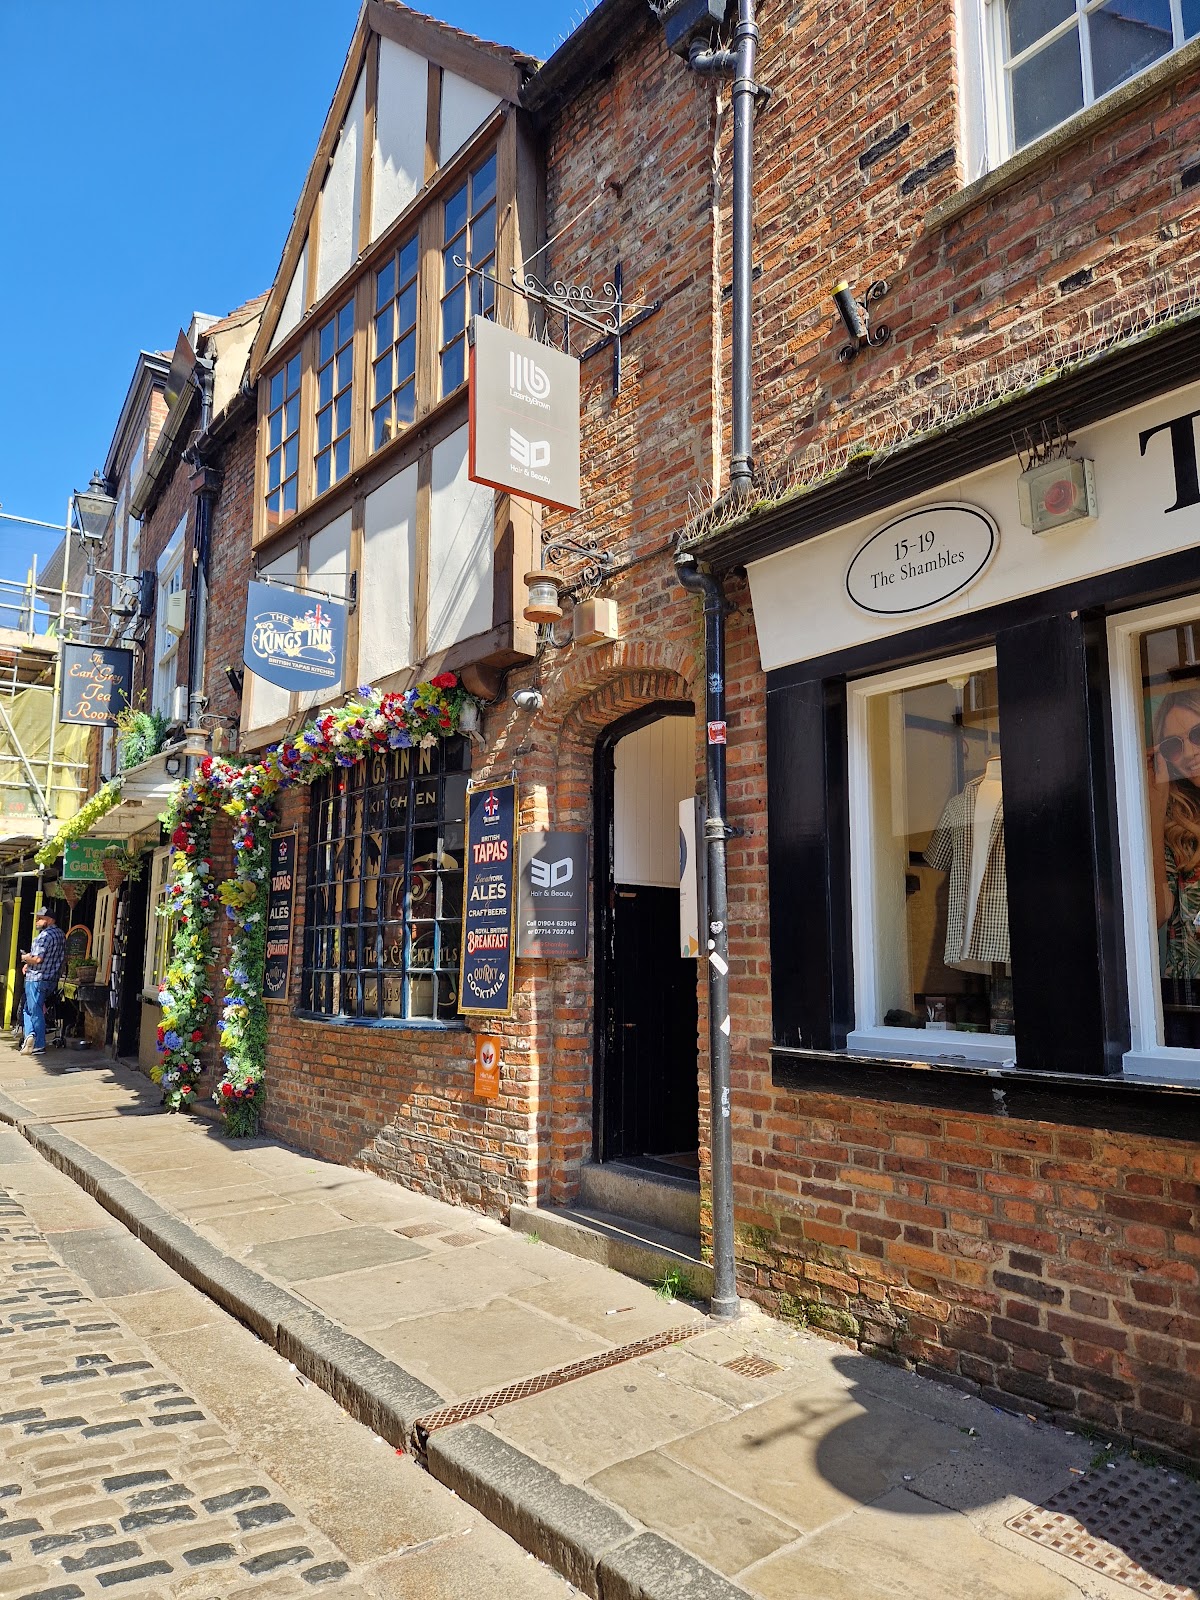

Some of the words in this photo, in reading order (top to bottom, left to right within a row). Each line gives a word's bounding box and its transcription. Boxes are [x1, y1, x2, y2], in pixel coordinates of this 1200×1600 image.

[509, 427, 551, 469] 3D
[510, 463, 523, 474] Hair
[523, 468, 530, 477] &
[530, 470, 551, 485] Beauty
[894, 530, 935, 561] 15-19
[870, 571, 895, 589] The
[900, 549, 965, 581] Shambles
[269, 613, 290, 623] THE
[259, 627, 302, 654] KINGS
[307, 628, 332, 651] INN
[89, 653, 104, 664] The
[268, 657, 292, 667] BRITISH
[291, 662, 311, 672] TAPAS
[311, 665, 336, 677] KITCHEN
[69, 663, 95, 679] Earl
[94, 665, 124, 685] Grey
[82, 683, 112, 701] Tea
[481, 833, 501, 843] BRITISH
[473, 840, 508, 863] TAPAS
[530, 857, 574, 888] 3D
[271, 874, 292, 892] TAPAS
[469, 882, 507, 901] ALES
[530, 890, 543, 898] Hair
[543, 889, 550, 898] &
[550, 889, 574, 899] Beauty
[269, 906, 290, 919] ALES
[468, 908, 488, 918] CRAFT
[488, 907, 507, 916] BEERS
[490, 926, 509, 934] BRITISH
[467, 930, 509, 954] BREAKFAST
[474, 963, 499, 983] QUIRKY
[466, 972, 506, 999] COCKTAILS
